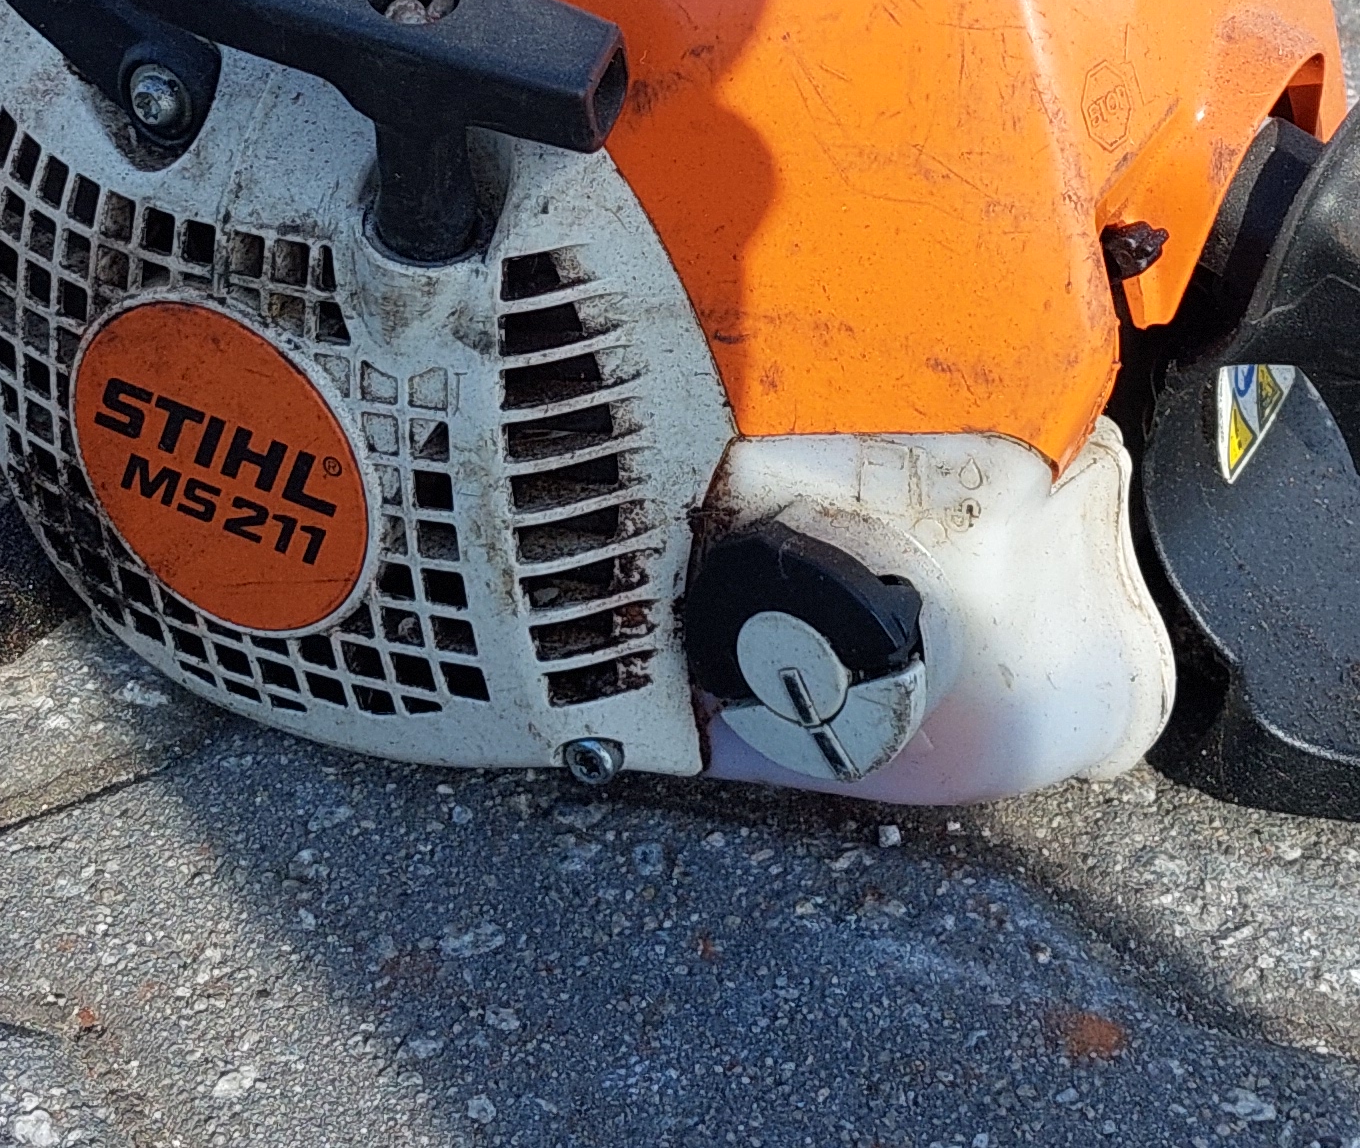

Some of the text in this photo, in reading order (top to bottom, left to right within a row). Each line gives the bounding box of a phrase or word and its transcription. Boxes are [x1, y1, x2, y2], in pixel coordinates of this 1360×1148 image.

[1086, 84, 1130, 129] STOP
[94, 377, 338, 518] STIHL
[120, 453, 328, 566] MS 211
